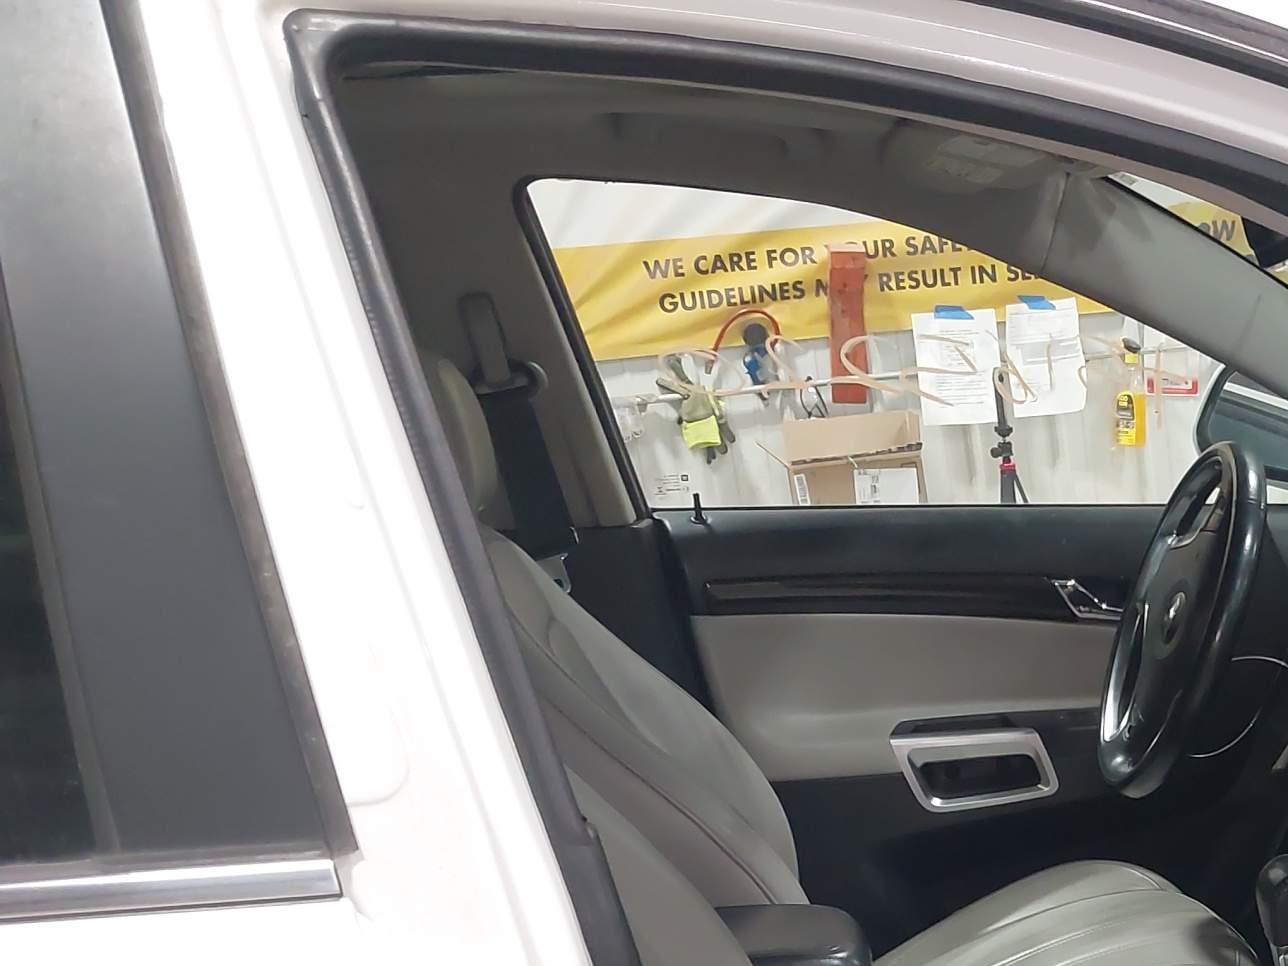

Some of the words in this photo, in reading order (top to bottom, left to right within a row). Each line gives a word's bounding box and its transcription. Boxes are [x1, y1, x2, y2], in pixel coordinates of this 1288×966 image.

[643, 257, 686, 280] WE
[694, 251, 758, 276] CARE
[766, 246, 817, 269] FOR
[659, 280, 806, 314] GUIDELINES
[878, 266, 962, 292] RESULT
[970, 264, 998, 285] IN
